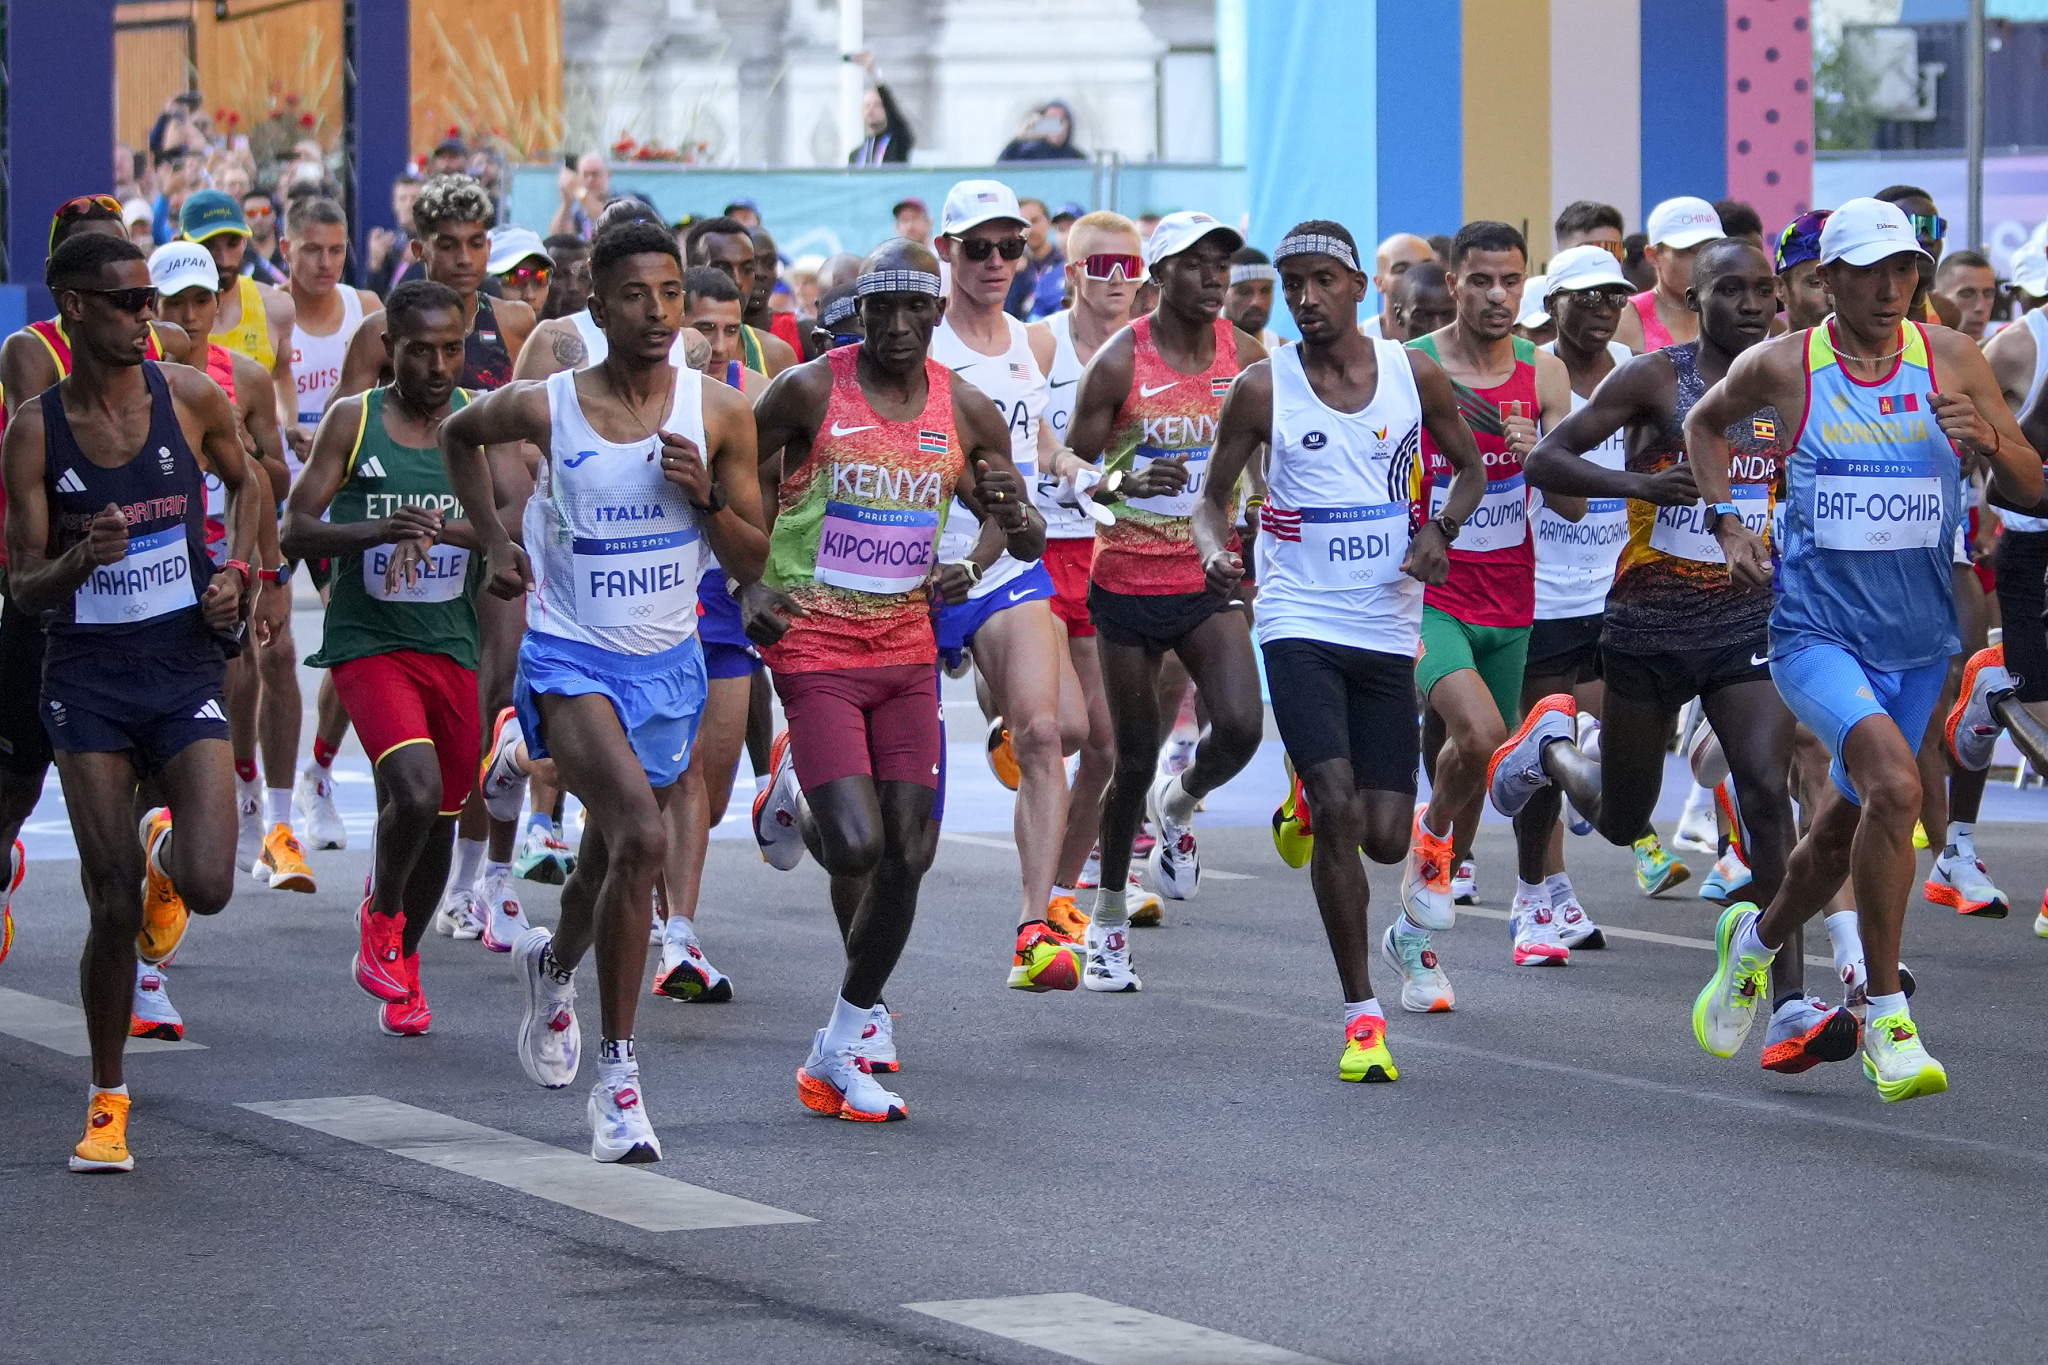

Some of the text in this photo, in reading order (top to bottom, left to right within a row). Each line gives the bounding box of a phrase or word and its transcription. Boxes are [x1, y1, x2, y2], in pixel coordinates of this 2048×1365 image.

[165, 257, 207, 274] JAPAN
[1143, 415, 1220, 444] KENY
[1822, 418, 1929, 446] MONGOLIA
[832, 462, 942, 505] KENYA
[1848, 464, 1913, 474] PARIS 2024
[122, 494, 188, 526] BRITAIN
[596, 504, 665, 521] ITALIA
[858, 511, 915, 523] PARIS 2024
[1329, 508, 1386, 520] PARIS 2024
[1463, 498, 1526, 528] OUMRI
[1657, 504, 1766, 536] KIPLAT
[1817, 491, 1941, 521] BAT-OCHIR
[131, 539, 158, 551] 2024
[605, 538, 671, 551] PARIS 2024
[823, 530, 932, 566] KIPCHOGE
[1329, 532, 1389, 562] ABDI
[78, 555, 187, 596] MAHAMED
[373, 552, 462, 579] BELE
[590, 561, 685, 598] FANIEL
